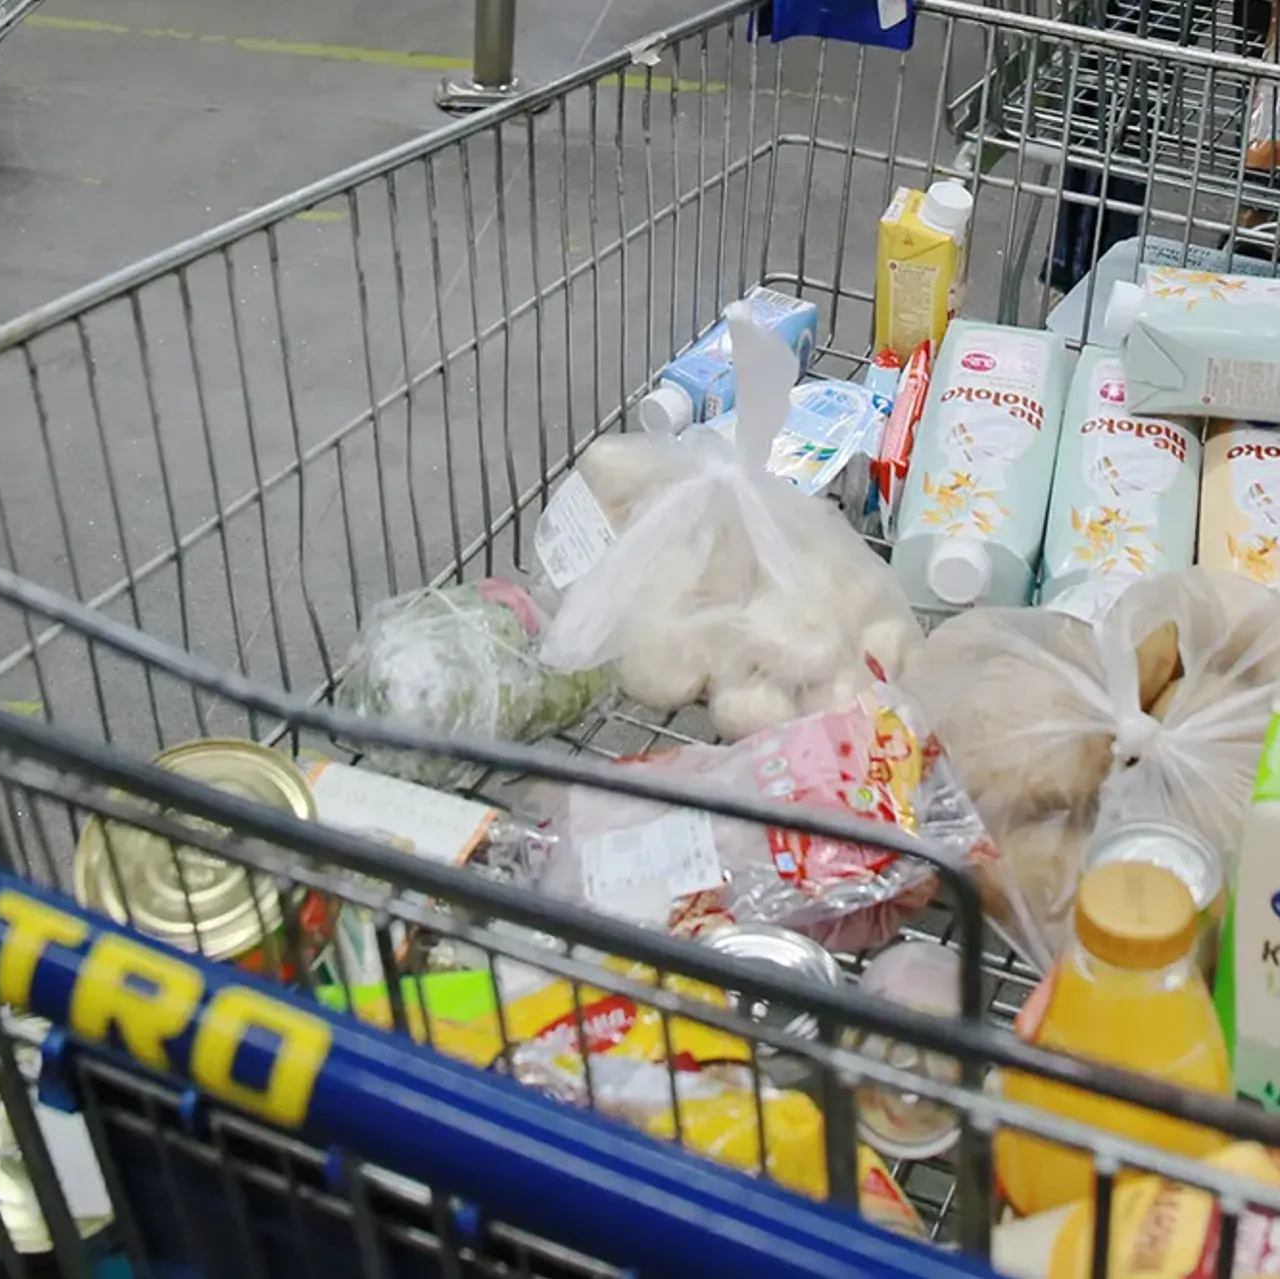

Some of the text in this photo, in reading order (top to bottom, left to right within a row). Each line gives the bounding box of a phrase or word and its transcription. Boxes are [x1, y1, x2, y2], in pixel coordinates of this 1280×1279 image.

[940, 385, 1045, 419] moloko
[1008, 408, 1043, 431] ne
[1080, 417, 1187, 449] moloko
[1153, 438, 1186, 463] ne
